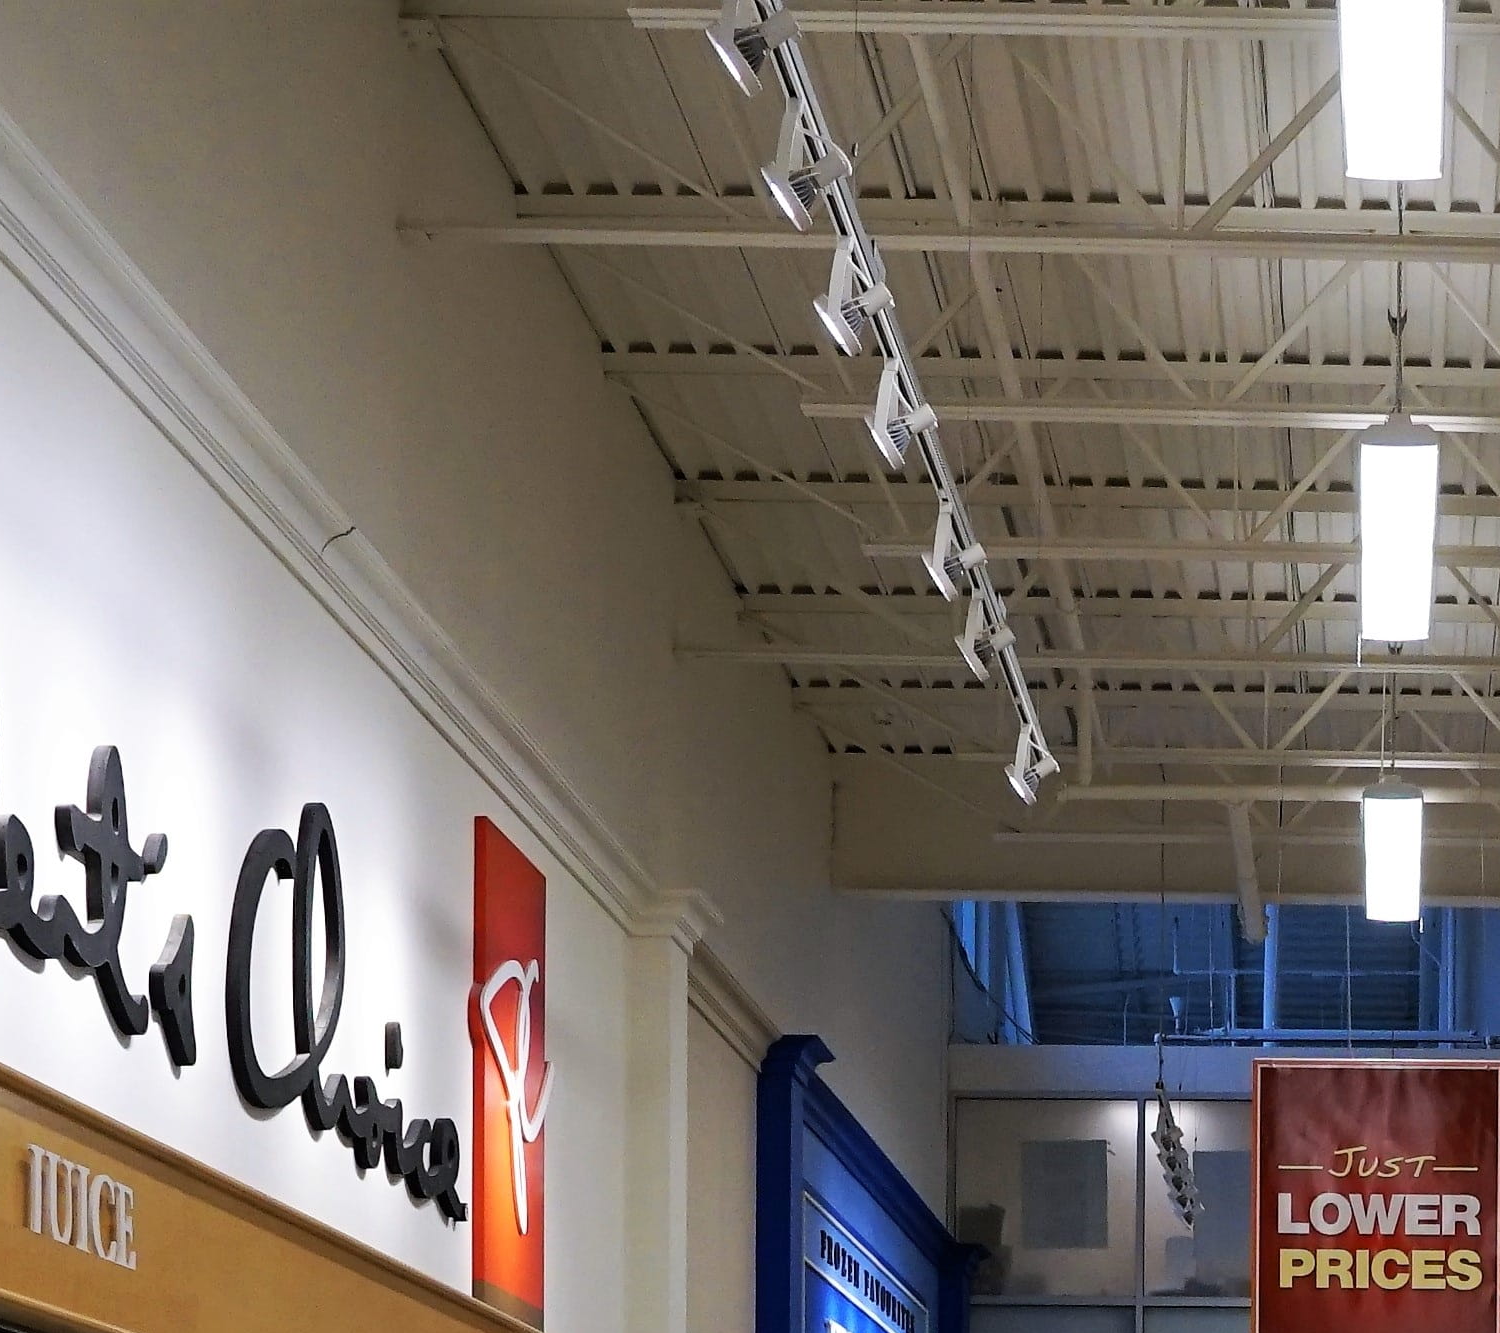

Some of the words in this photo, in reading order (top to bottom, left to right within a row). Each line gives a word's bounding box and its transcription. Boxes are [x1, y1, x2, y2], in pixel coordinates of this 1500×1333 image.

[225, 802, 469, 1224] Choice
[21, 1143, 137, 1270] JUICE
[1277, 1192, 1482, 1237] LOWER
[820, 1230, 861, 1289] FROZEN
[1279, 1249, 1483, 1290] PRICES
